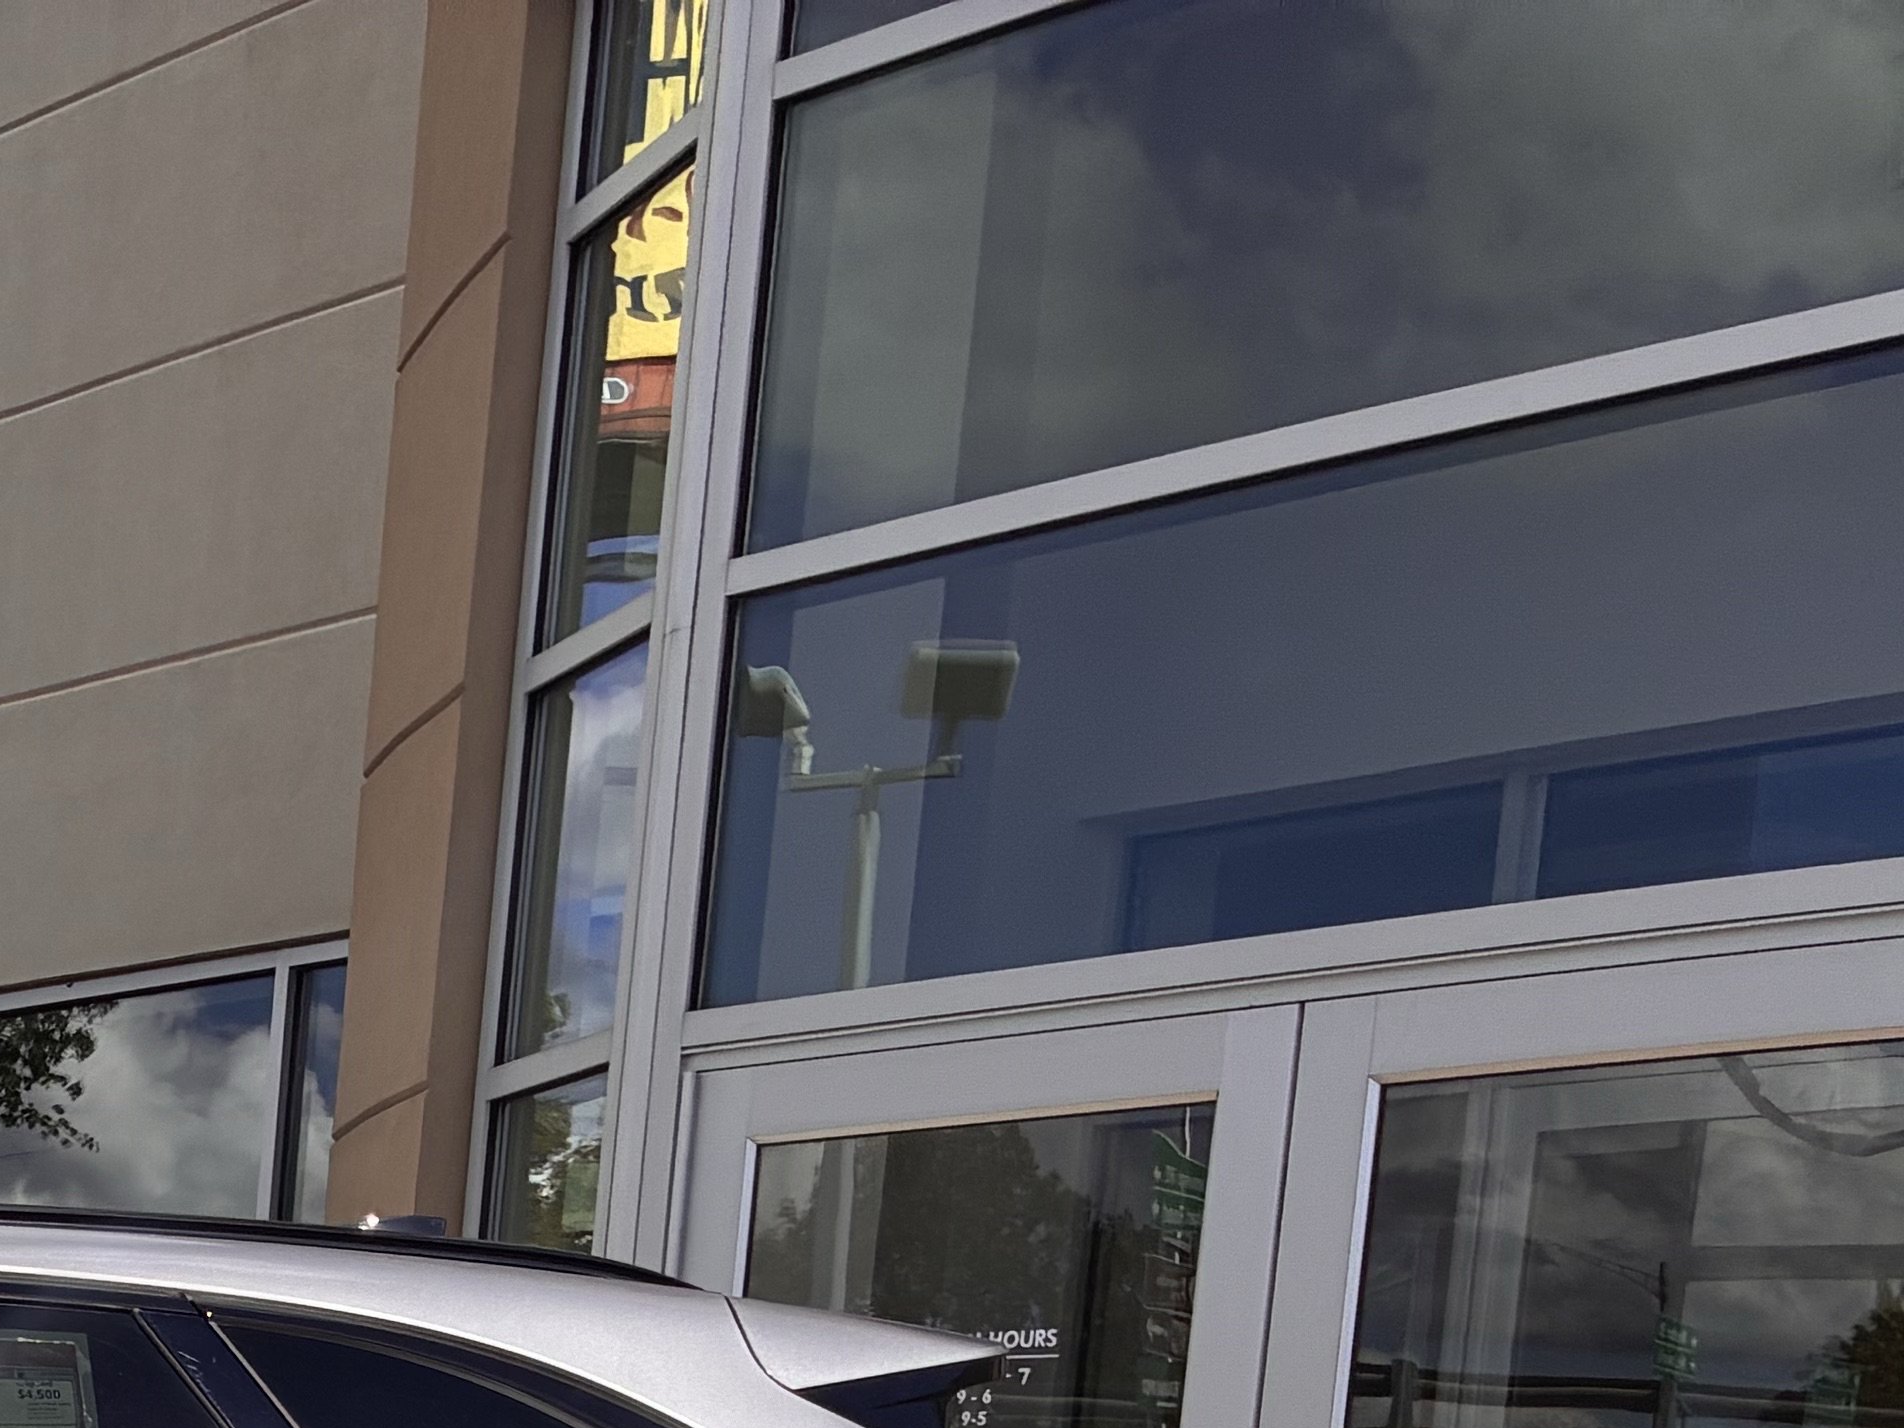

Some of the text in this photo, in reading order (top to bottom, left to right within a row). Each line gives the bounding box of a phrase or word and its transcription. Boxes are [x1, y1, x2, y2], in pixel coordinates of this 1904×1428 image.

[989, 1328, 1059, 1349] HOURS
[1017, 1367, 1032, 1386] 7
[956, 1389, 967, 1405] 9
[982, 1388, 992, 1405] 6
[960, 1410, 988, 1427] 9-5
